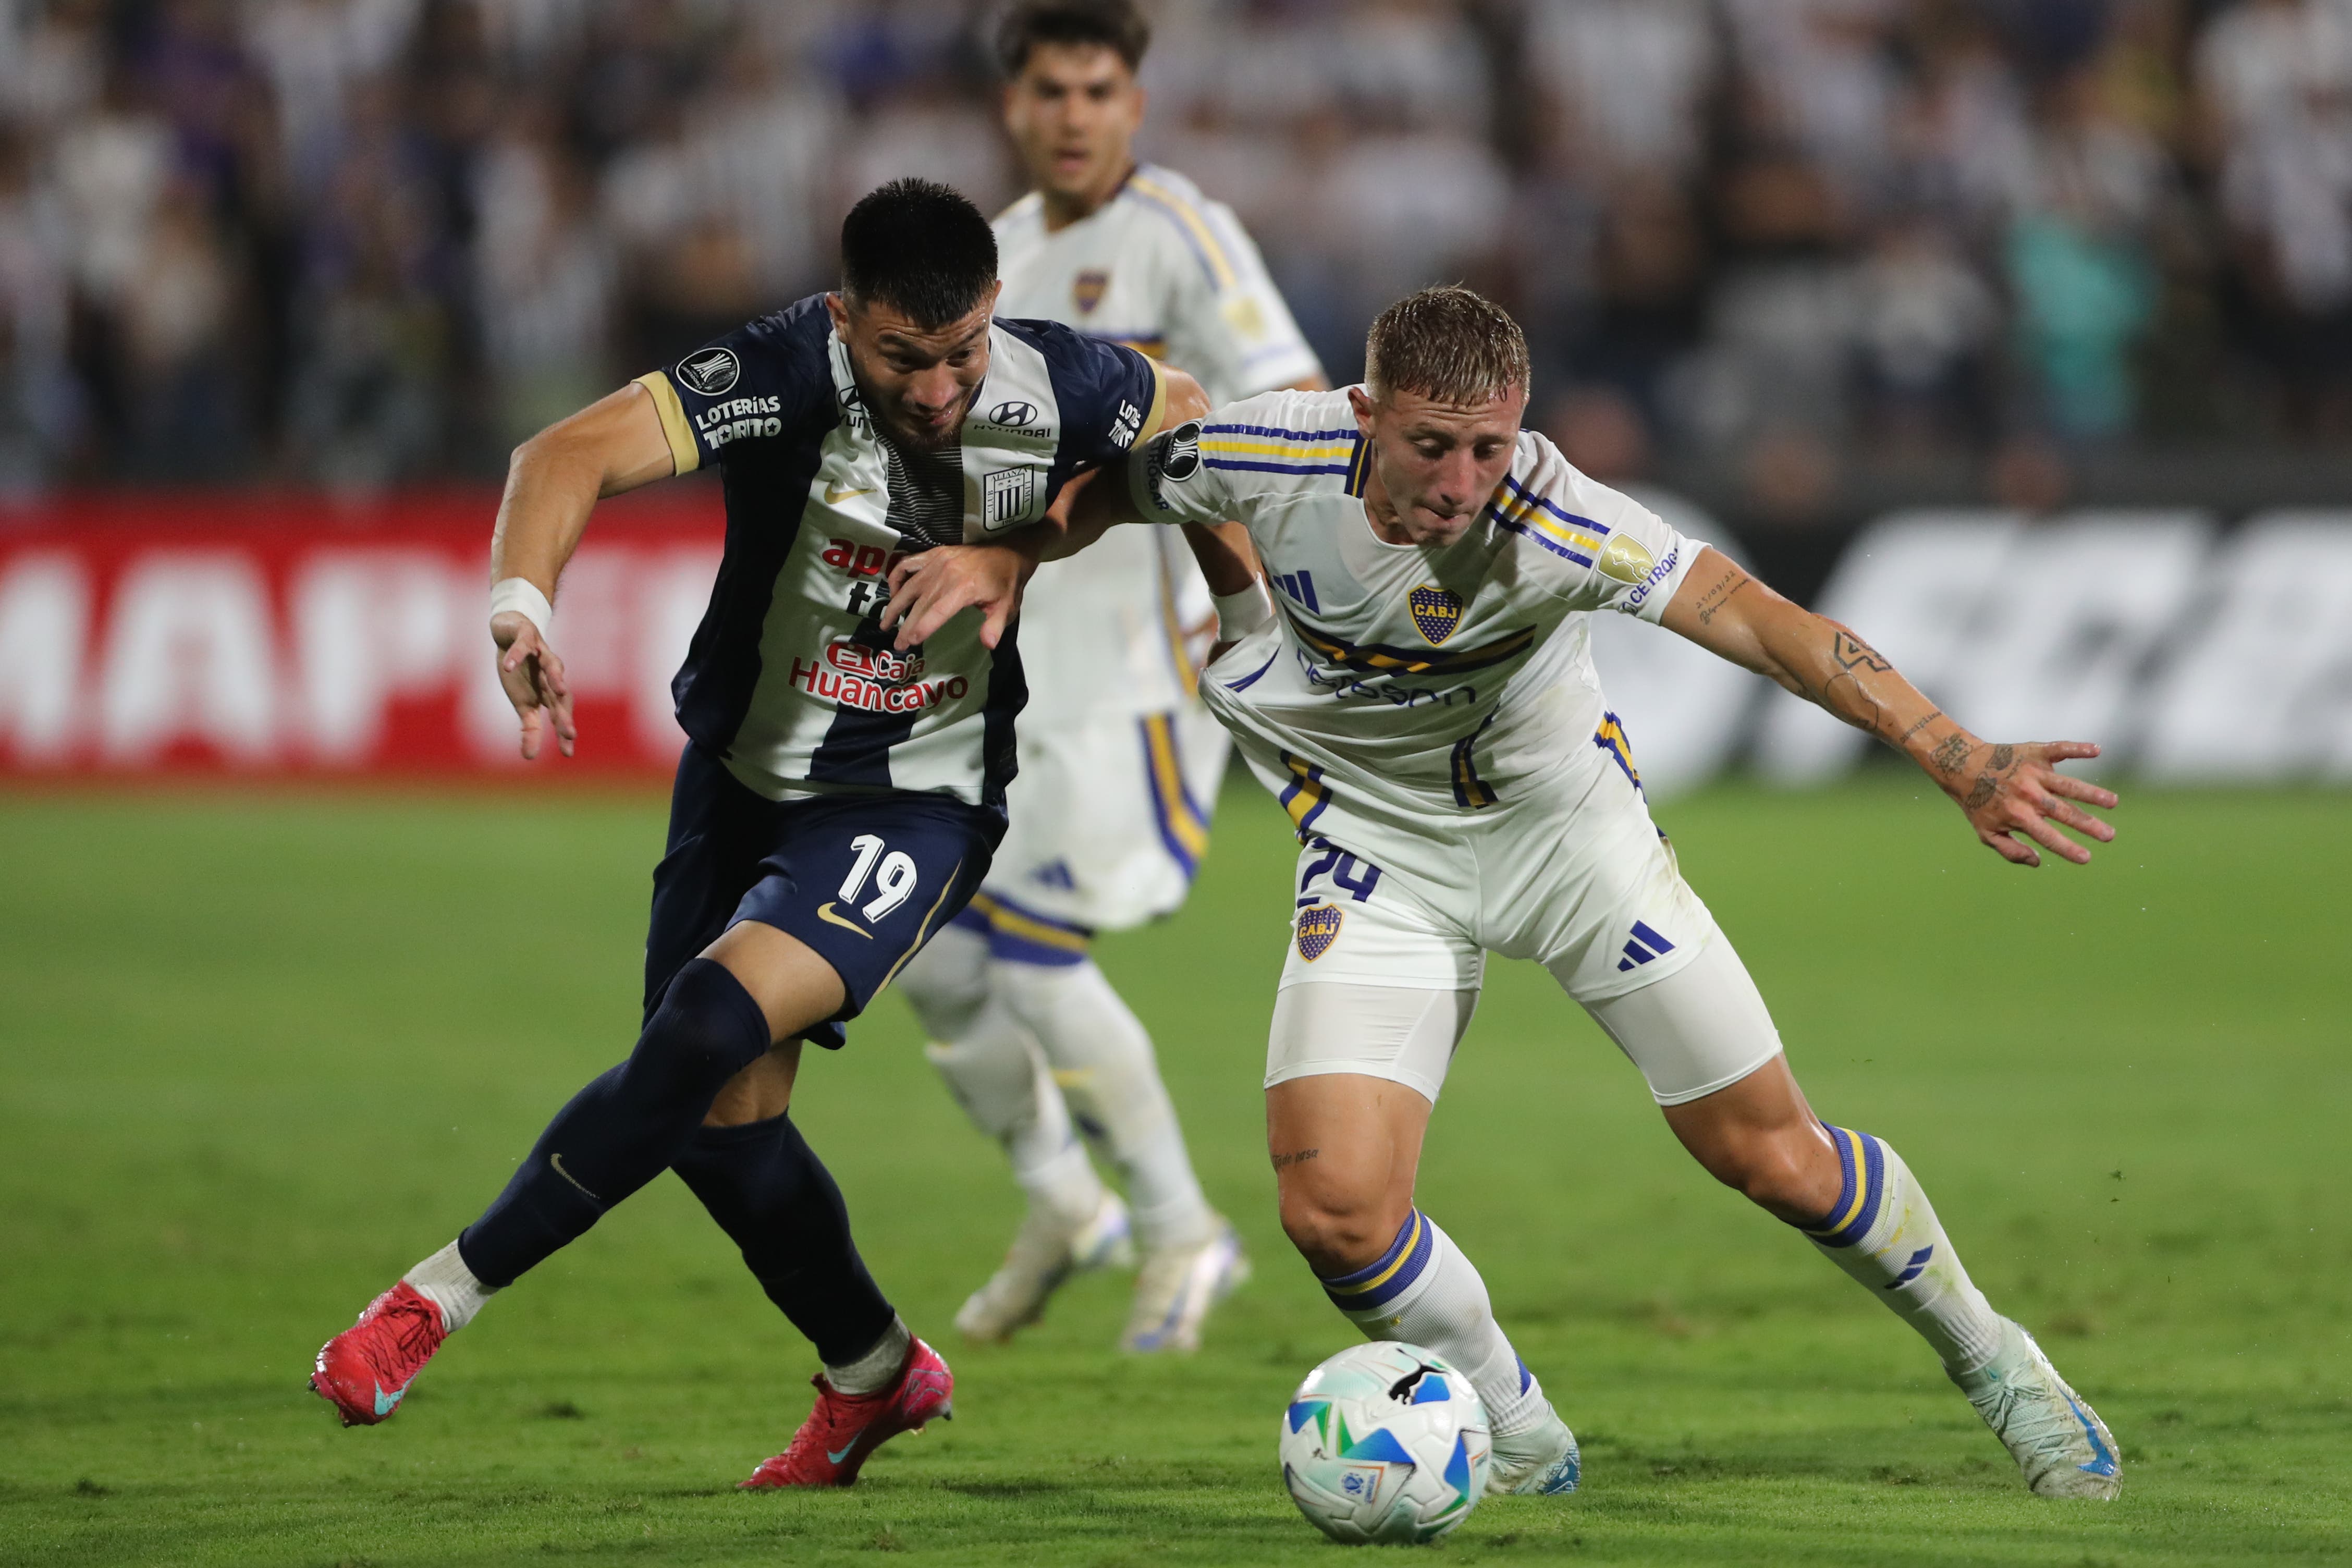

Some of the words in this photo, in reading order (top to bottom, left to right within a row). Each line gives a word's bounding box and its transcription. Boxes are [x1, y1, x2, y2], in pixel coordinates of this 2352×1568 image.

[703, 416, 781, 450] TORITO
[991, 468, 1027, 481] ALIANZA
[1415, 604, 1457, 619] CABJ
[876, 652, 925, 682] Caja
[789, 656, 969, 712] Huancayo
[838, 834, 917, 924] 19
[1299, 923, 1336, 938] CABJ
